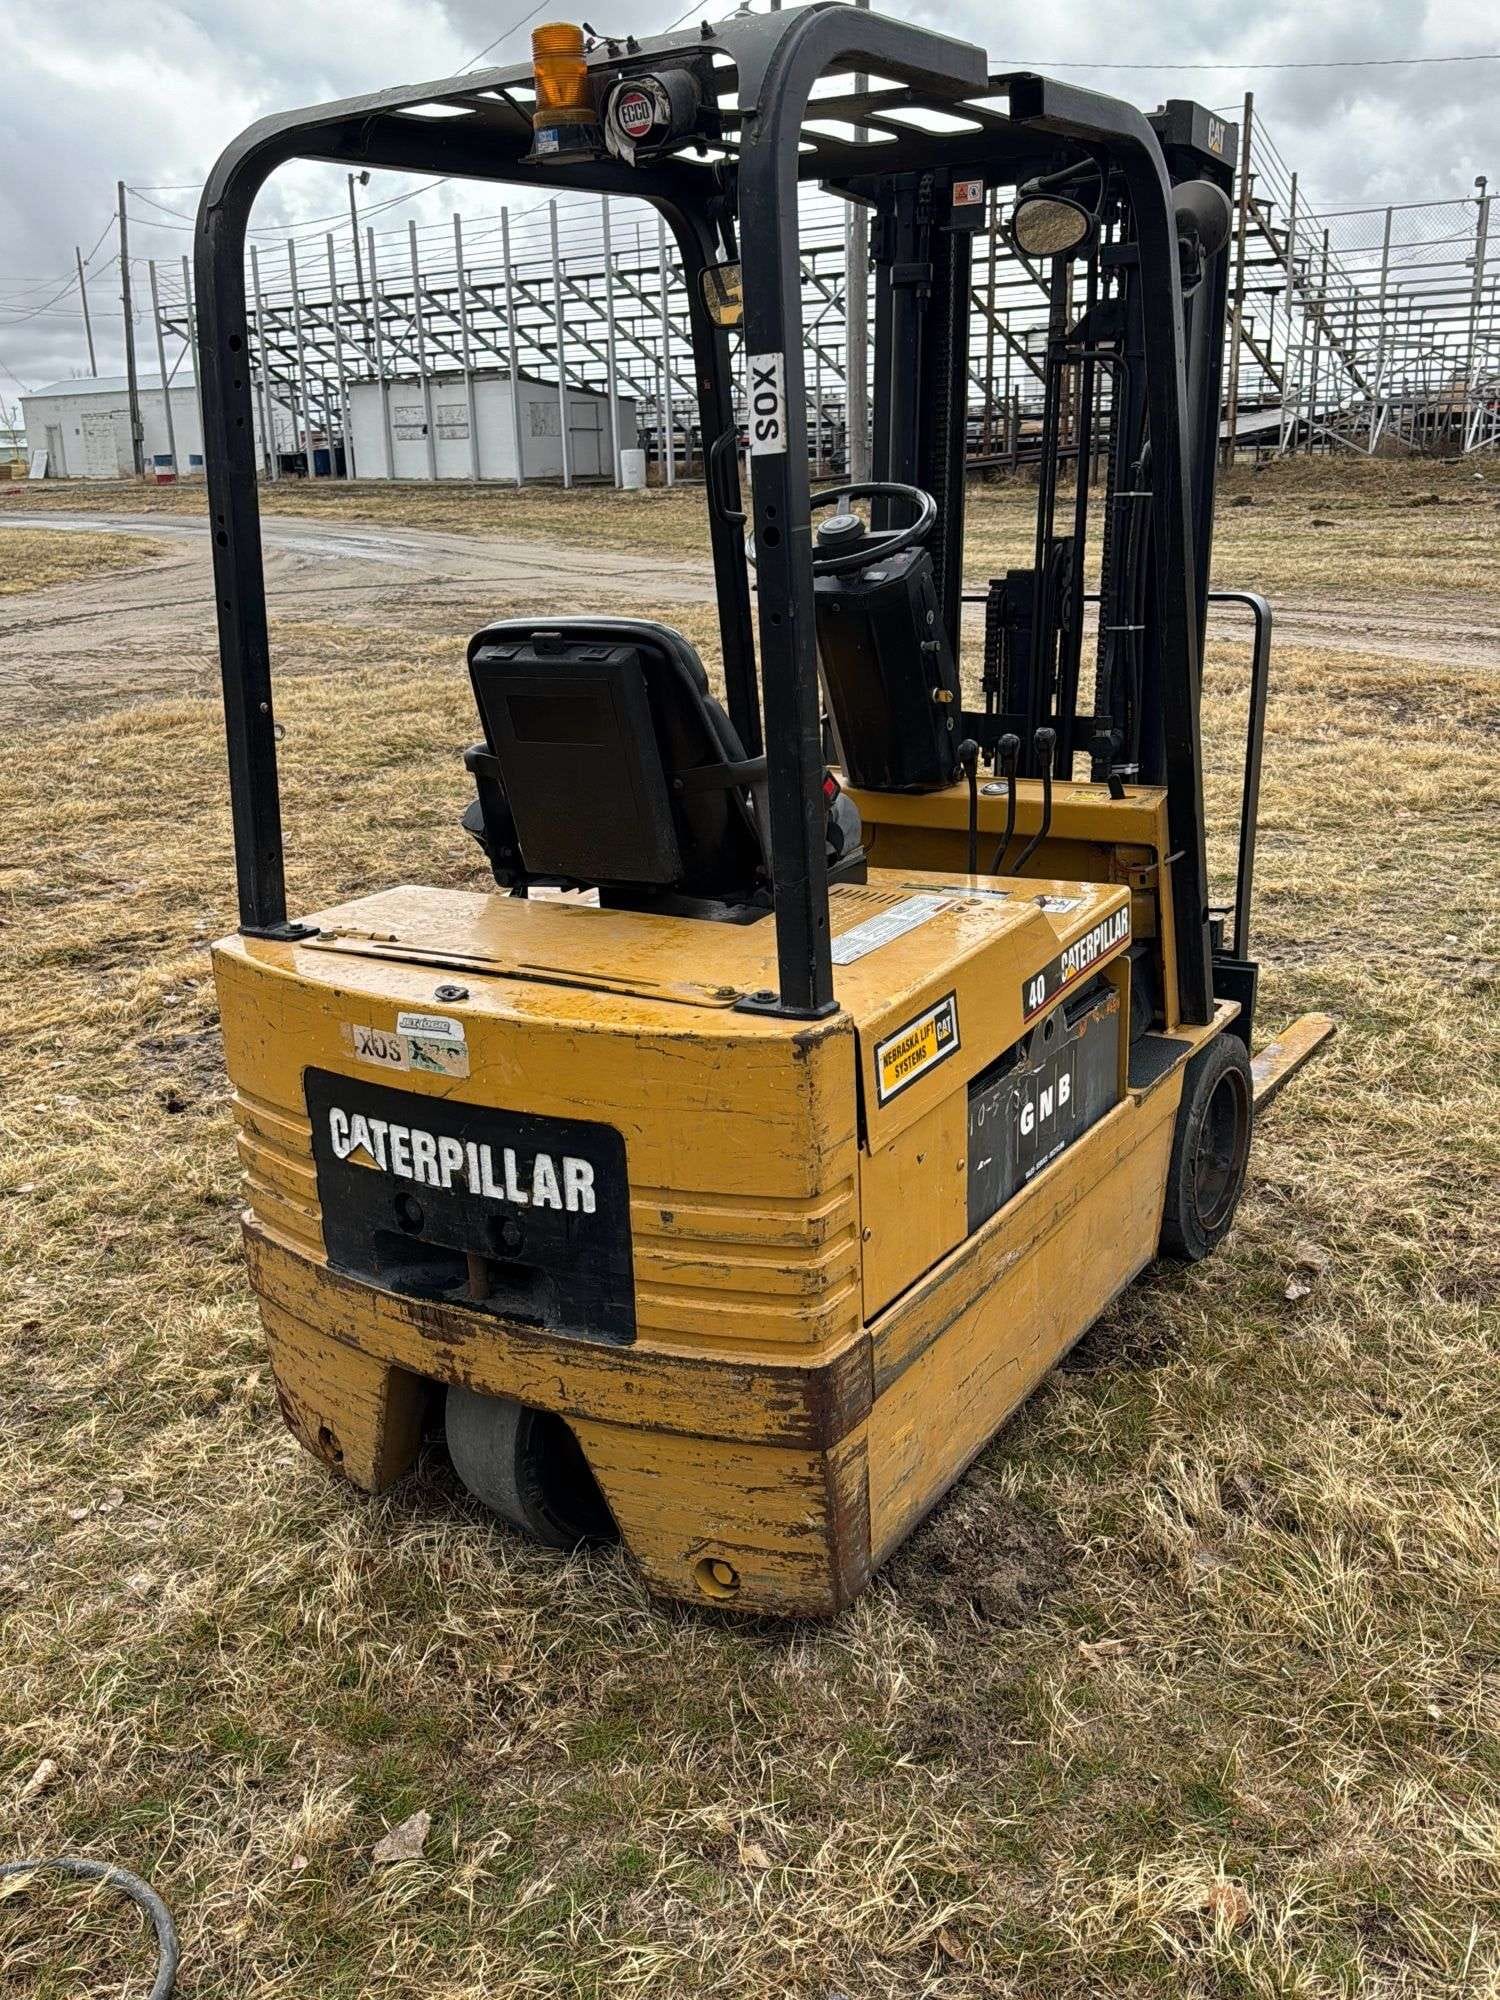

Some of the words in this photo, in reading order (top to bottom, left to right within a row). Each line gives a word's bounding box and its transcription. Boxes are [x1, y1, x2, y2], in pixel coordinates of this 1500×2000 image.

[622, 102, 650, 123] ECCO
[1208, 117, 1226, 153] CAT
[1028, 974, 1046, 1009] 40
[1061, 906, 1129, 982] CATERPILLAR
[883, 1034, 920, 1067] NEBRASKA
[920, 1020, 935, 1042] LIFT
[936, 1015, 952, 1041] CAT
[894, 1045, 927, 1078] SYSTEMS
[329, 1107, 597, 1214] CATERPILLAR
